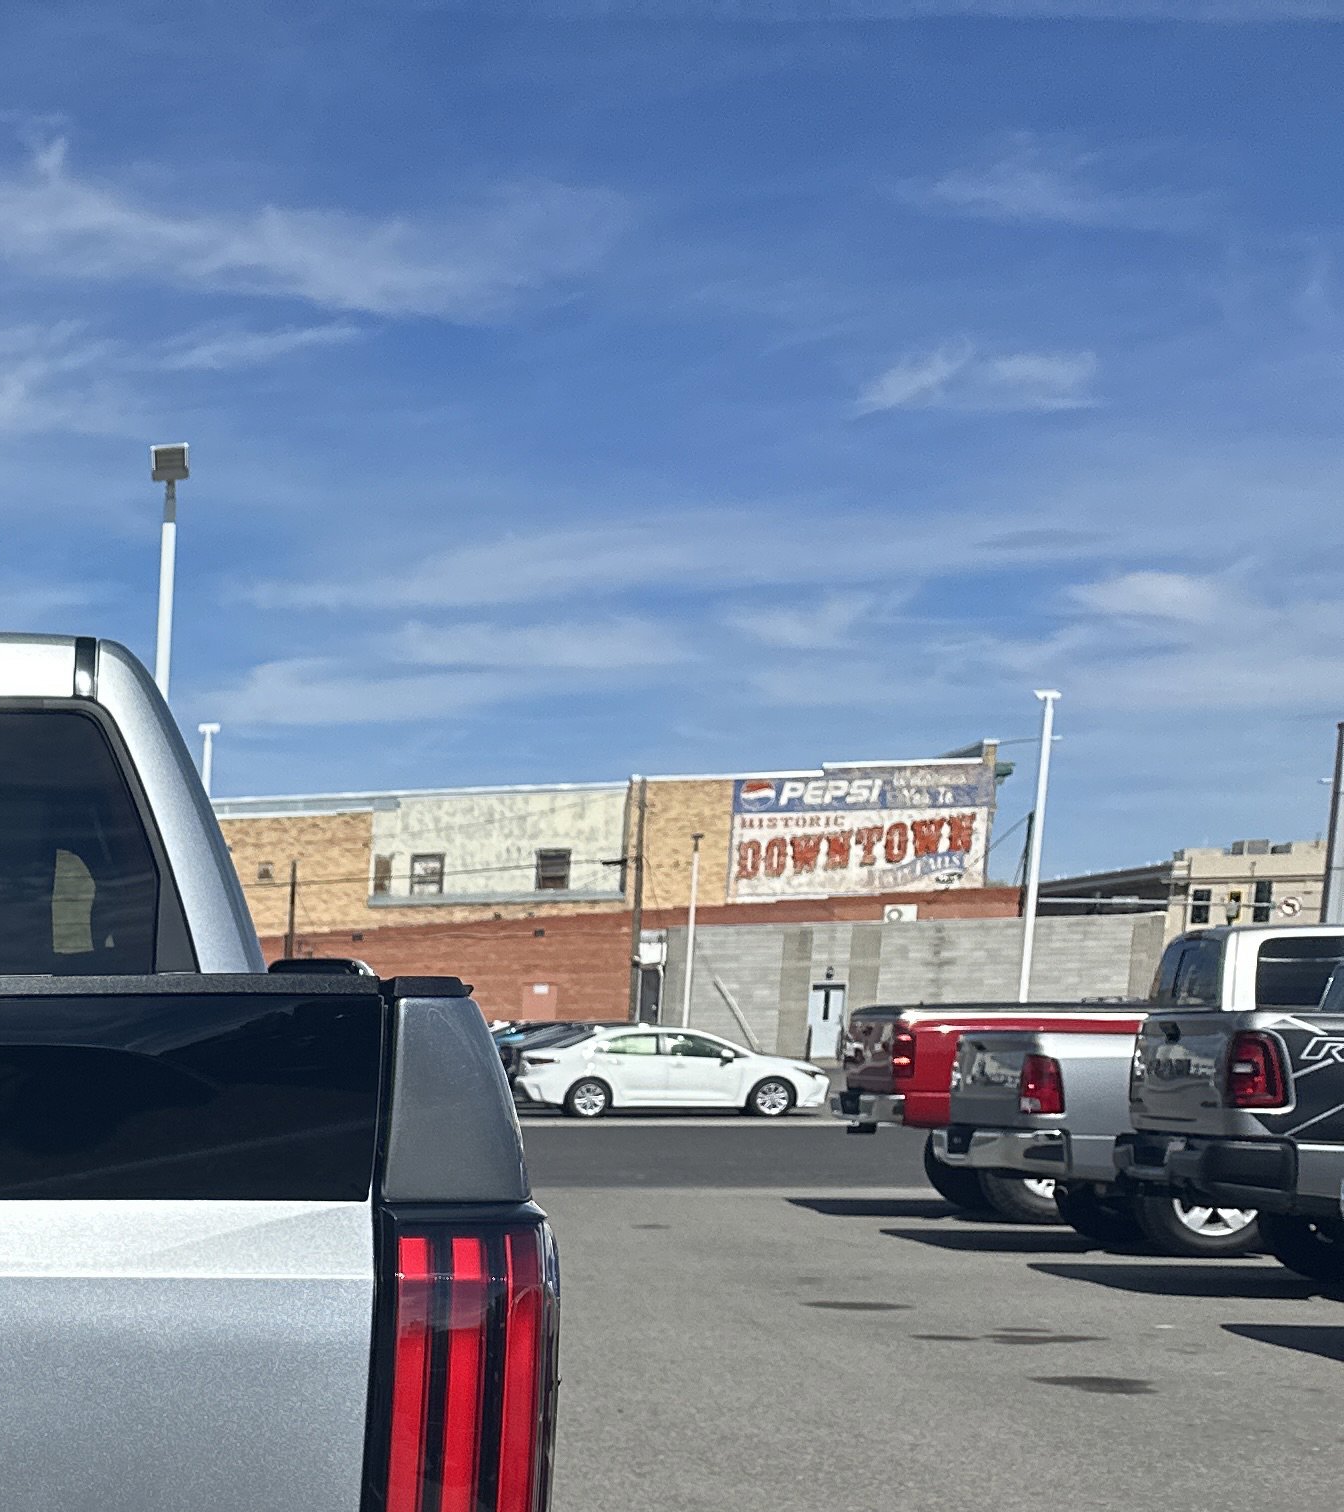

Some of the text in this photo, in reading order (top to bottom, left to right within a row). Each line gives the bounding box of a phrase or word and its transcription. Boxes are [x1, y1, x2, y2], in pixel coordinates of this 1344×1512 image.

[779, 778, 883, 807] PEPSI
[739, 814, 846, 831] HISTORIC
[736, 811, 977, 882] DOWNTOWN
